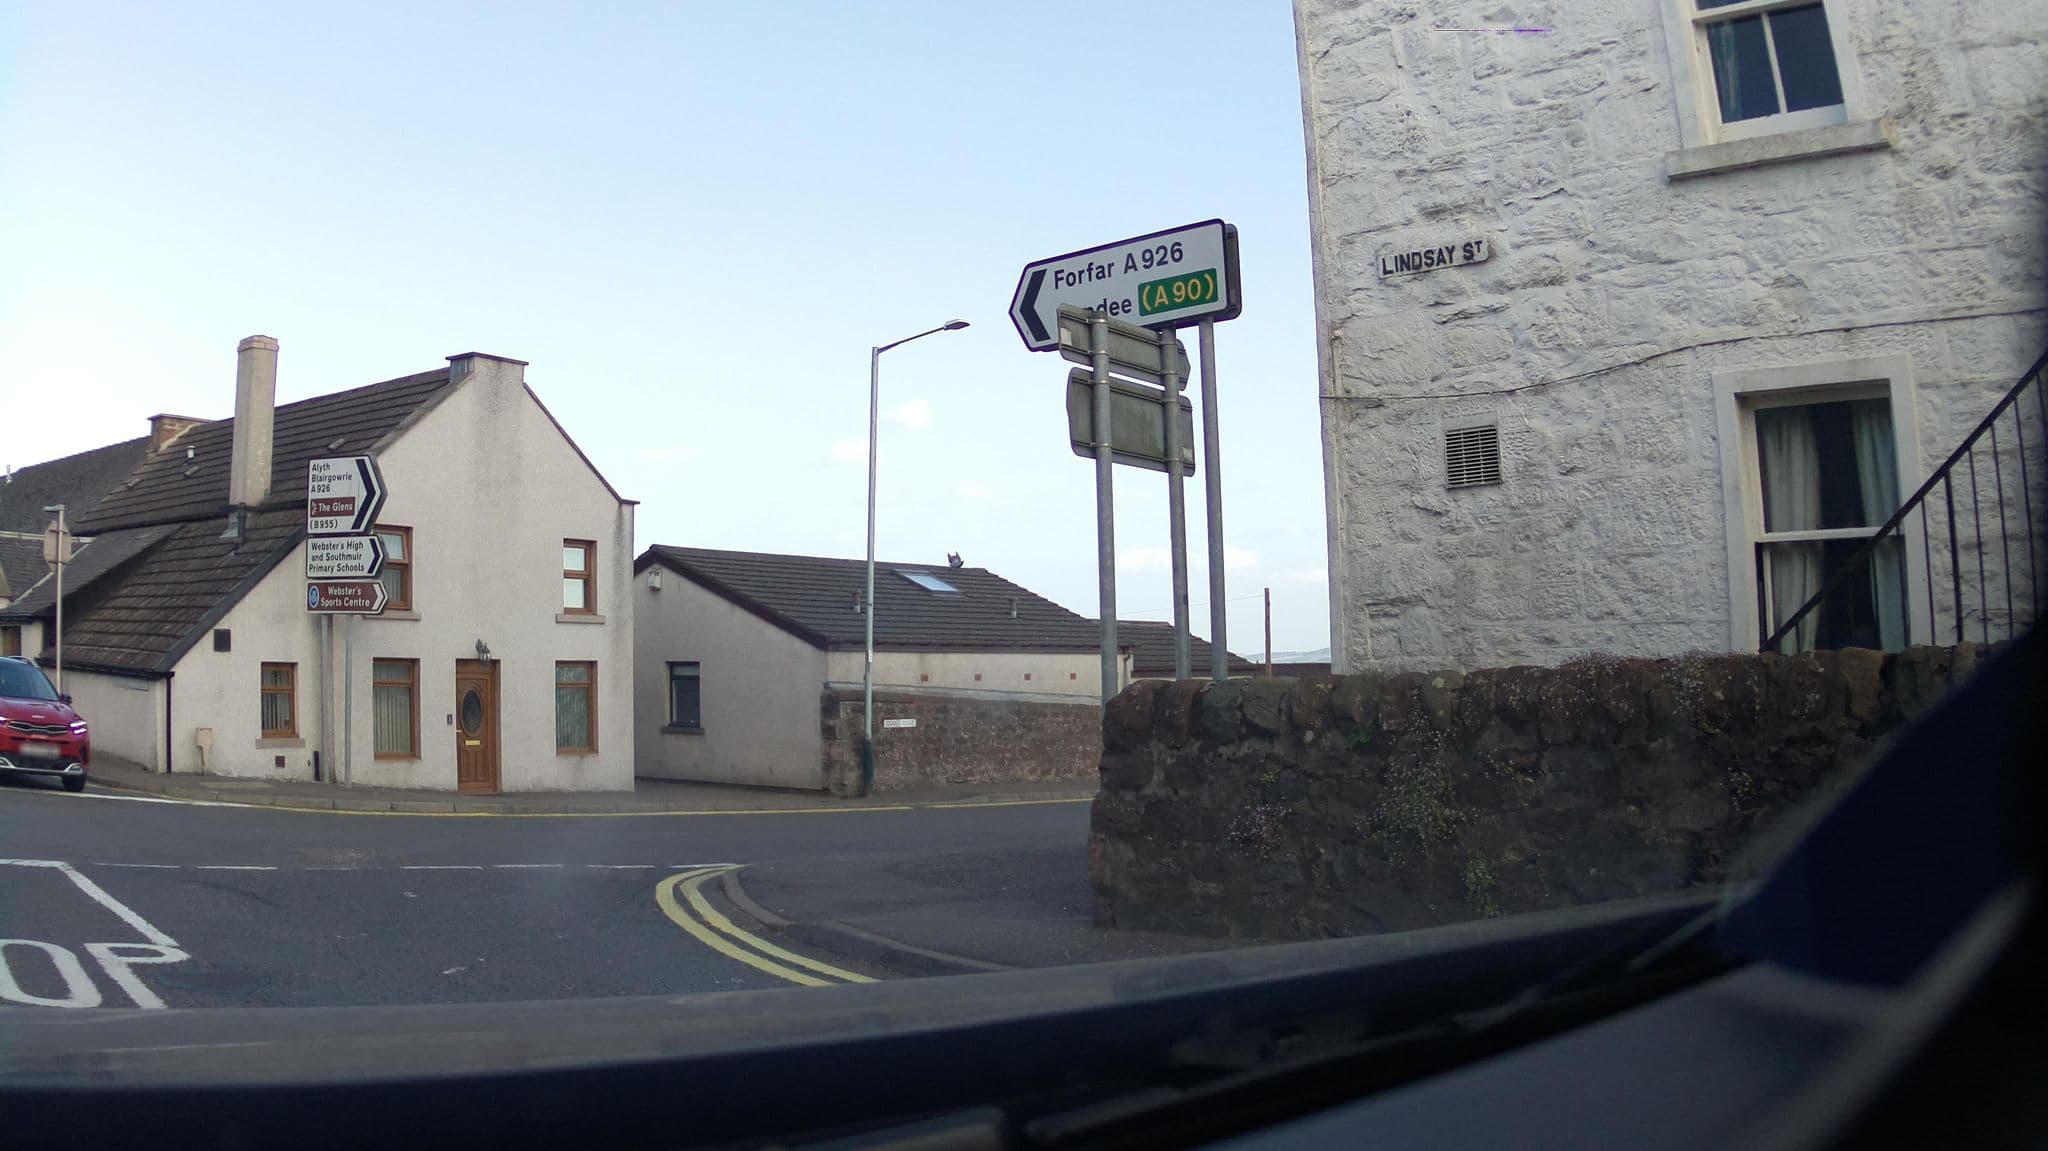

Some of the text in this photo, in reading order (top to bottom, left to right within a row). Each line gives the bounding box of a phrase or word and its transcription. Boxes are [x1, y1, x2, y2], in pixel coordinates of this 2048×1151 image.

[1382, 240, 1483, 275] LINDSAY ST
[1054, 241, 1184, 290] Forfar A926
[1083, 272, 1214, 317] dee (A90)
[311, 462, 331, 473] Alyth
[311, 472, 353, 483] Blairgowrie
[311, 484, 331, 493] A926
[319, 502, 353, 512] The Glens
[310, 519, 338, 529] (B955)
[311, 541, 364, 551] Webster's High
[312, 553, 363, 561] and Southmuir
[309, 563, 365, 573] Primary Schools
[328, 586, 361, 596] Webster's
[320, 597, 370, 607] Sports Centre
